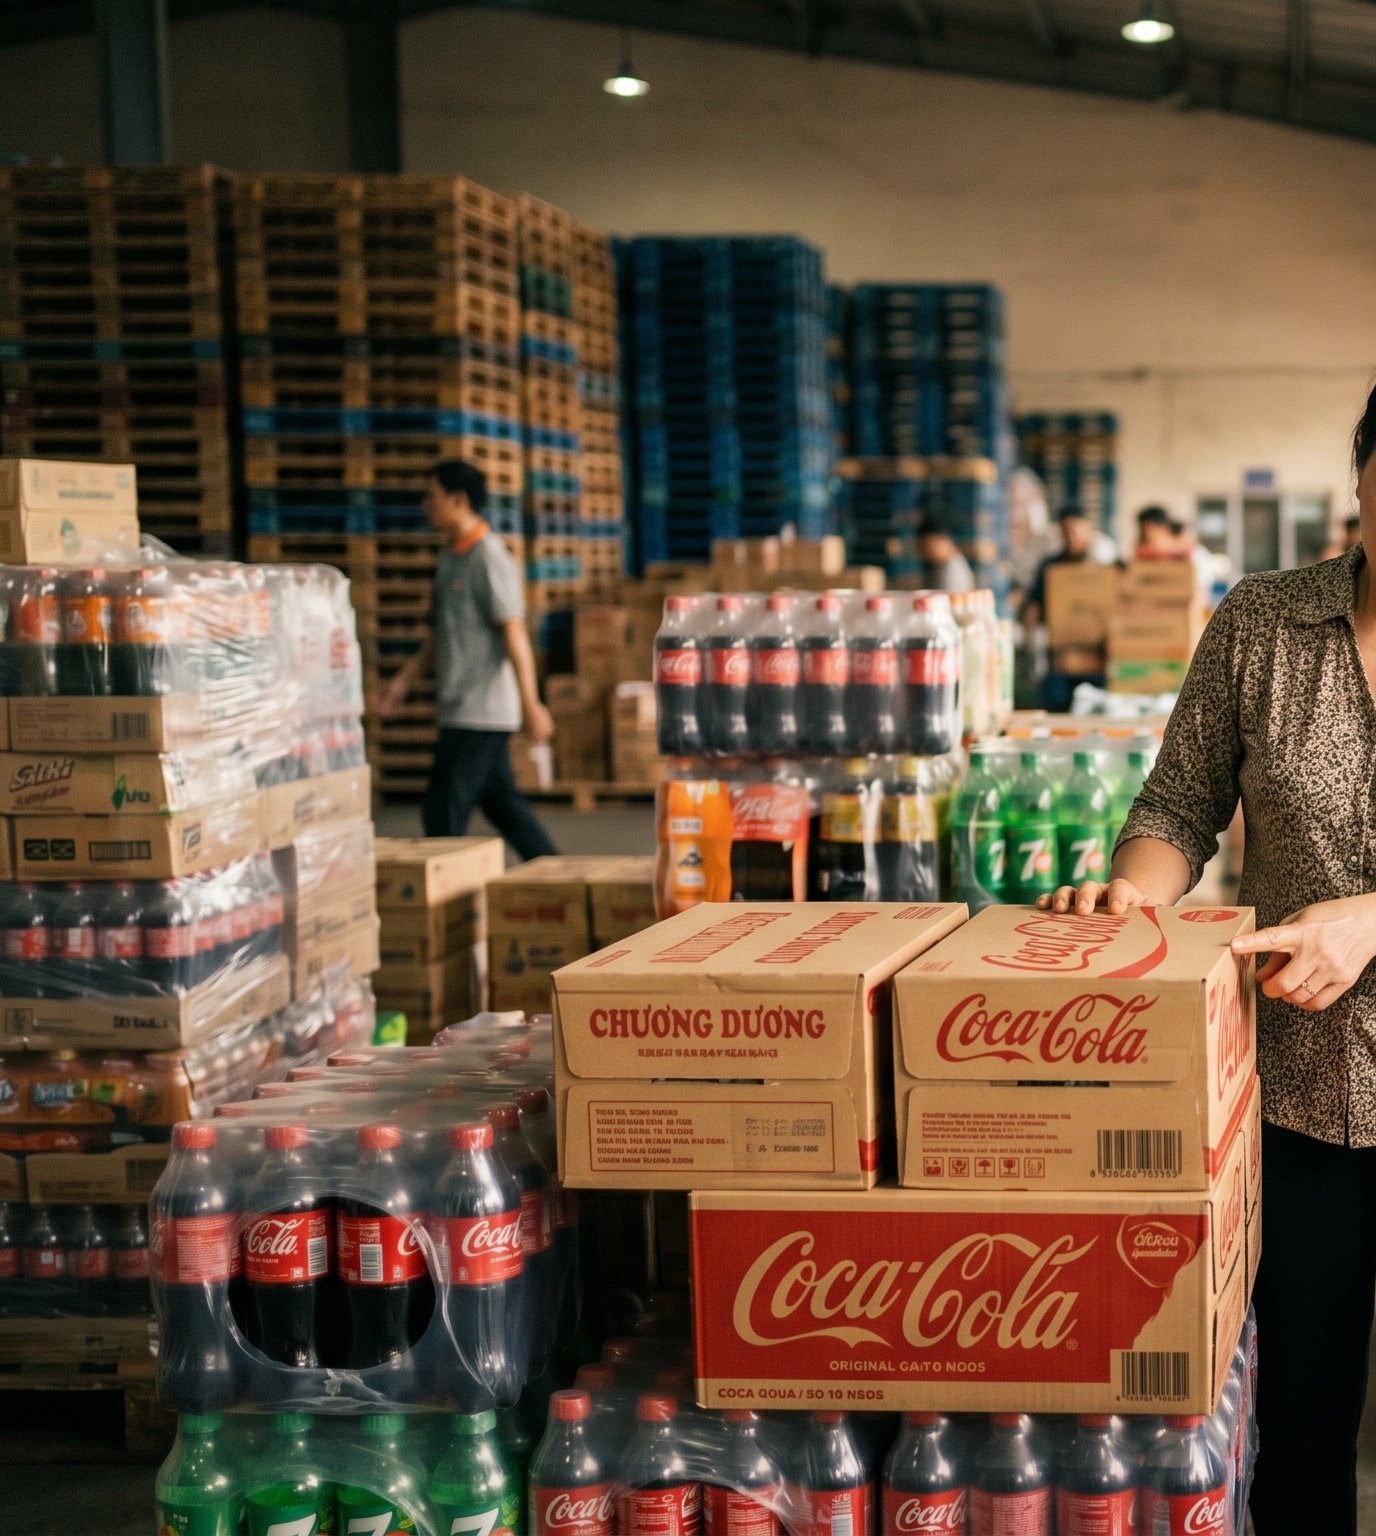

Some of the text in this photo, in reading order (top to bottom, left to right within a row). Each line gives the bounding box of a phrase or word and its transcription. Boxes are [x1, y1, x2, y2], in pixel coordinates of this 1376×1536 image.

[589, 1003, 826, 1039] CHƯƠNG DƯƠNG
[936, 992, 1160, 1065] Coca-Cola
[732, 1229, 1100, 1350] Coca-Cola
[829, 1359, 896, 1372] ORIGINAL
[945, 1361, 986, 1373] NOOS
[717, 1386, 755, 1399] COCA
